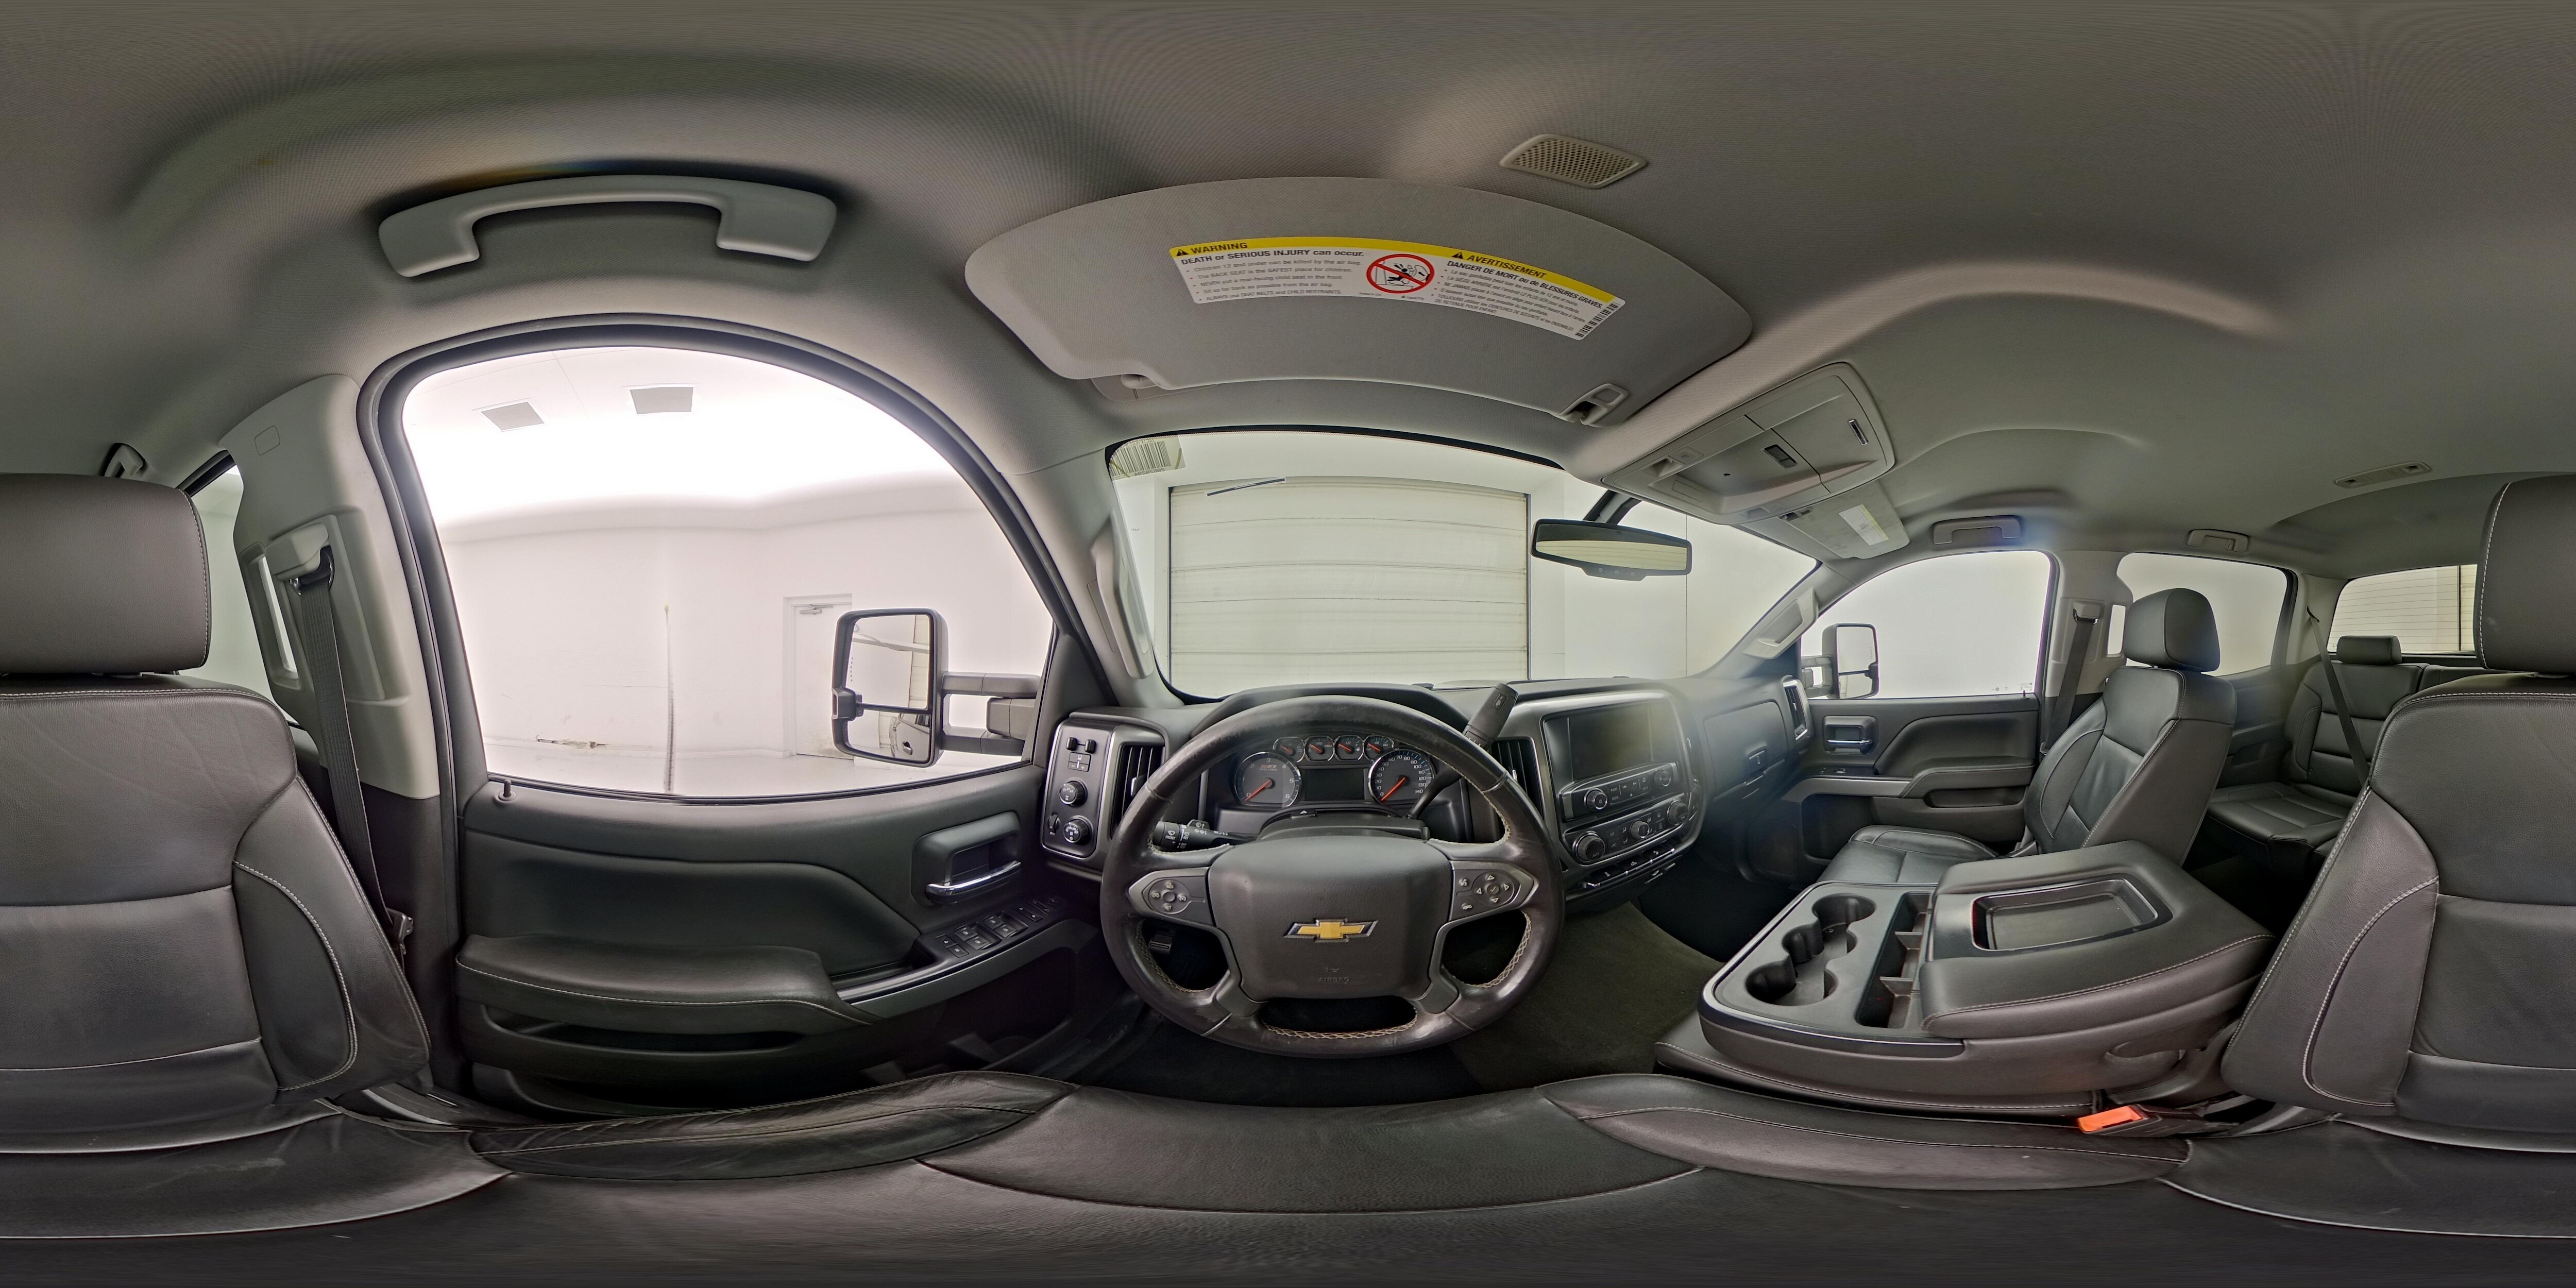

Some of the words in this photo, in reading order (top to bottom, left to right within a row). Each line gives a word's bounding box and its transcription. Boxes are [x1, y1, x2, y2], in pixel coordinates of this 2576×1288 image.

[1191, 242, 1247, 253] WARNING
[1181, 256, 1212, 264] DEATH
[1228, 251, 1270, 259] SERIOUS
[1467, 255, 1547, 278] AVERTISSEMENT
[1447, 261, 1482, 272] DANGER
[1495, 270, 1519, 280] MORT
[1540, 283, 1579, 299] BLESSURES
[1578, 296, 1603, 309] GRAVES.
